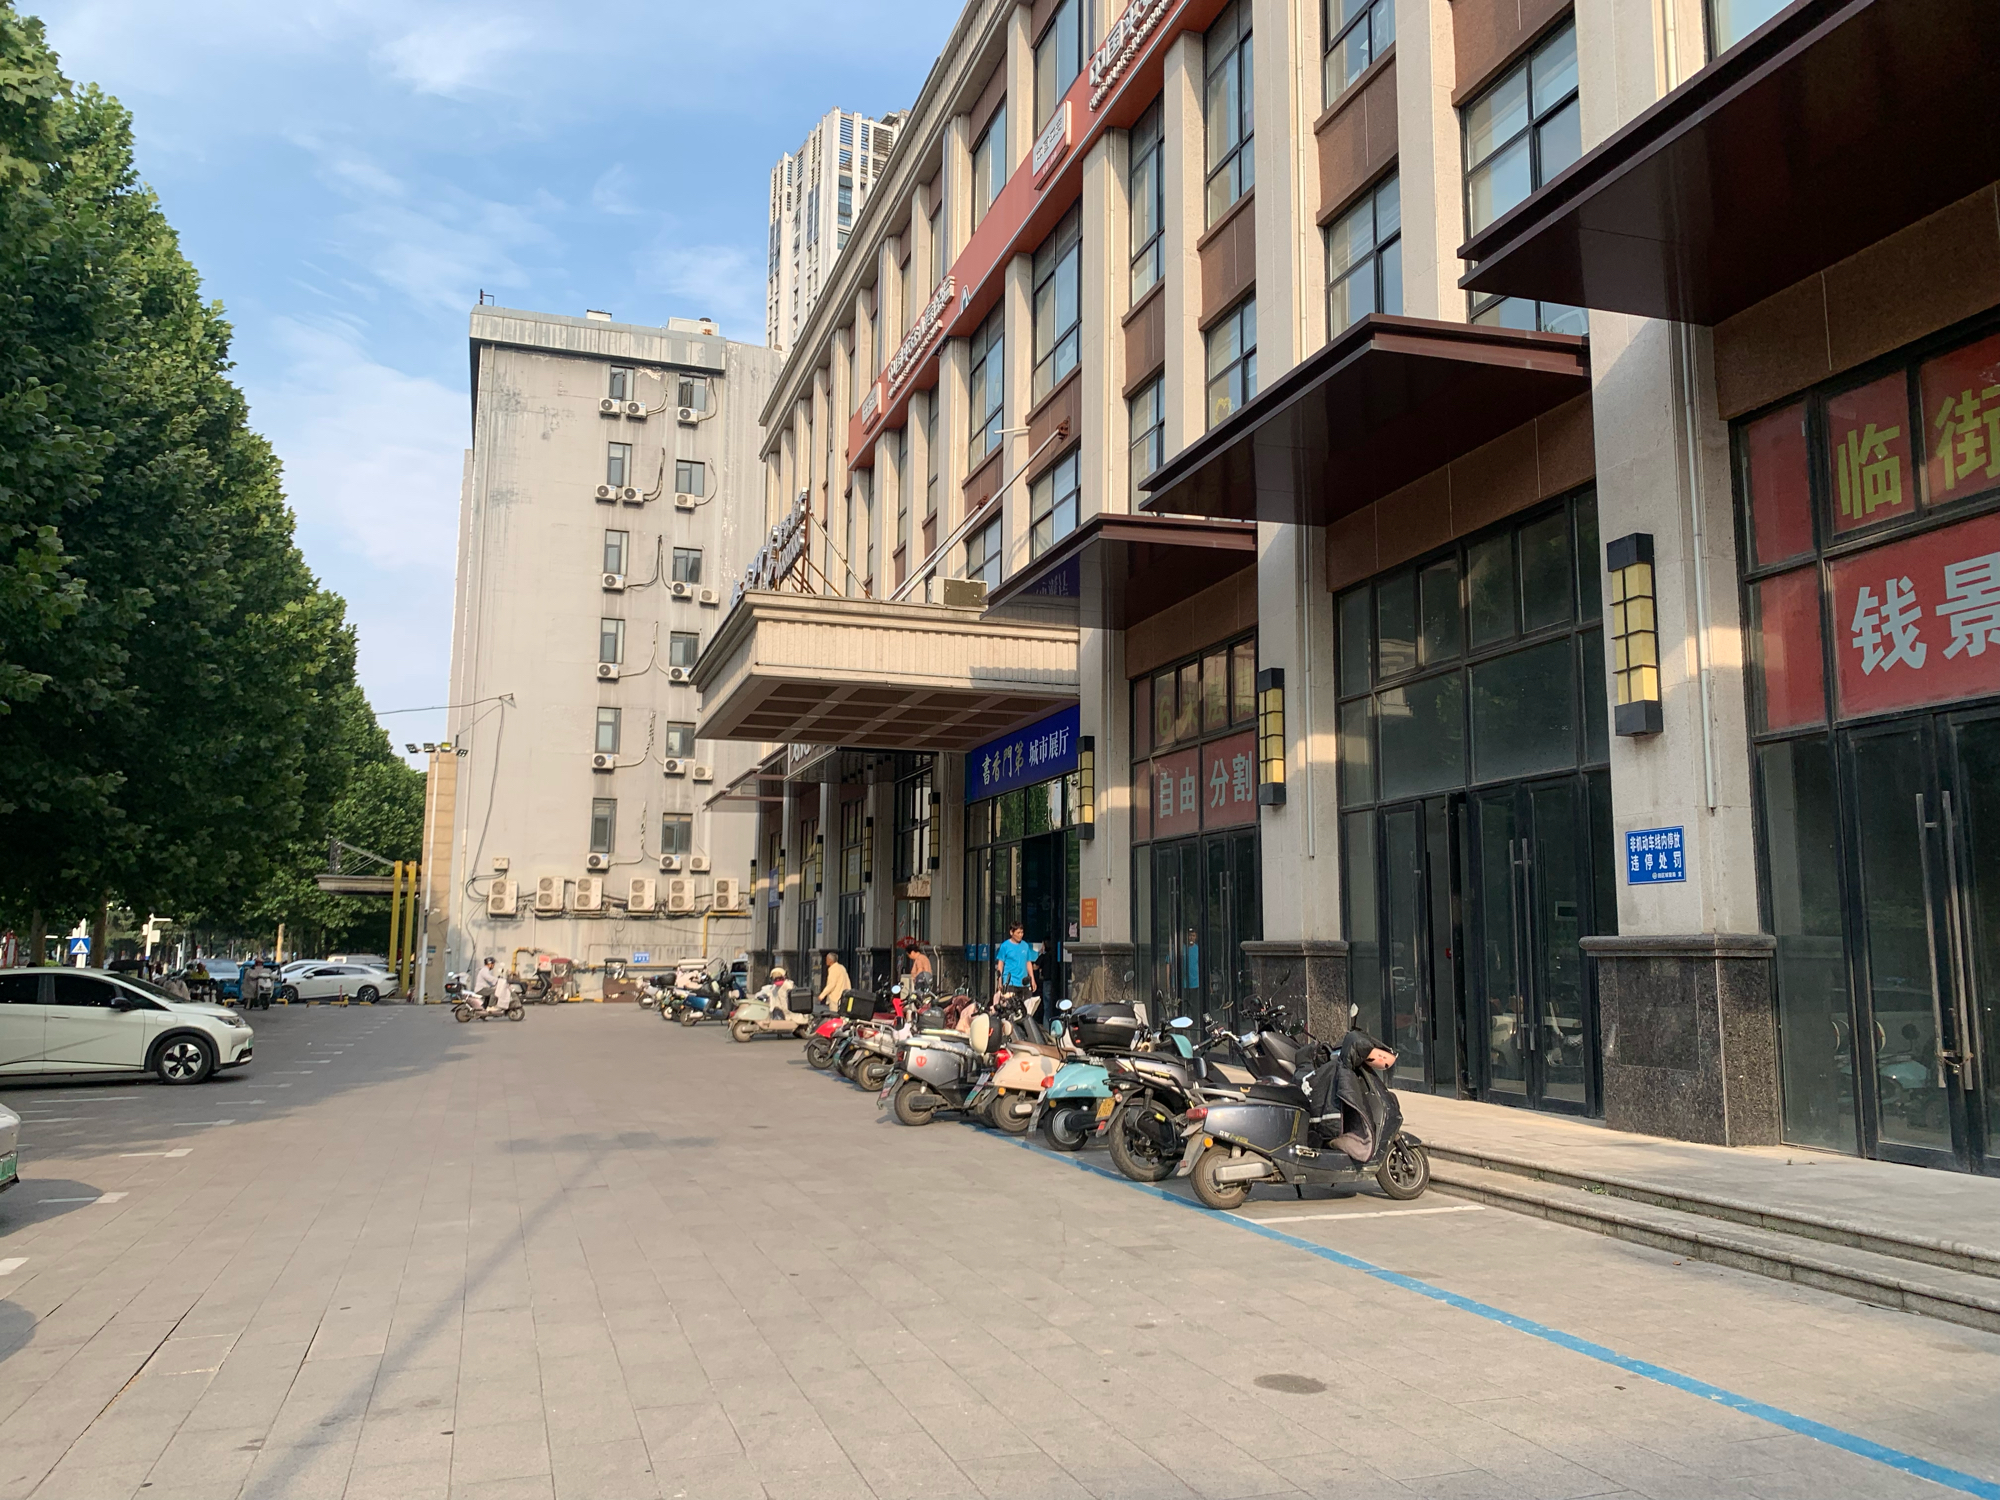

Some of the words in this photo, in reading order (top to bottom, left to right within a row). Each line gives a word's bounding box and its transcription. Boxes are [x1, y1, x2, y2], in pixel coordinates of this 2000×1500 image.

[1837, 387, 2000, 519] 临街
[1851, 552, 2000, 676] 钱景
[1028, 726, 1070, 767] 城市展厅
[1159, 750, 1253, 819] 自由分割
[1630, 832, 1680, 853] 非机动车线内停放
[1631, 852, 1681, 871] 违停处罚
